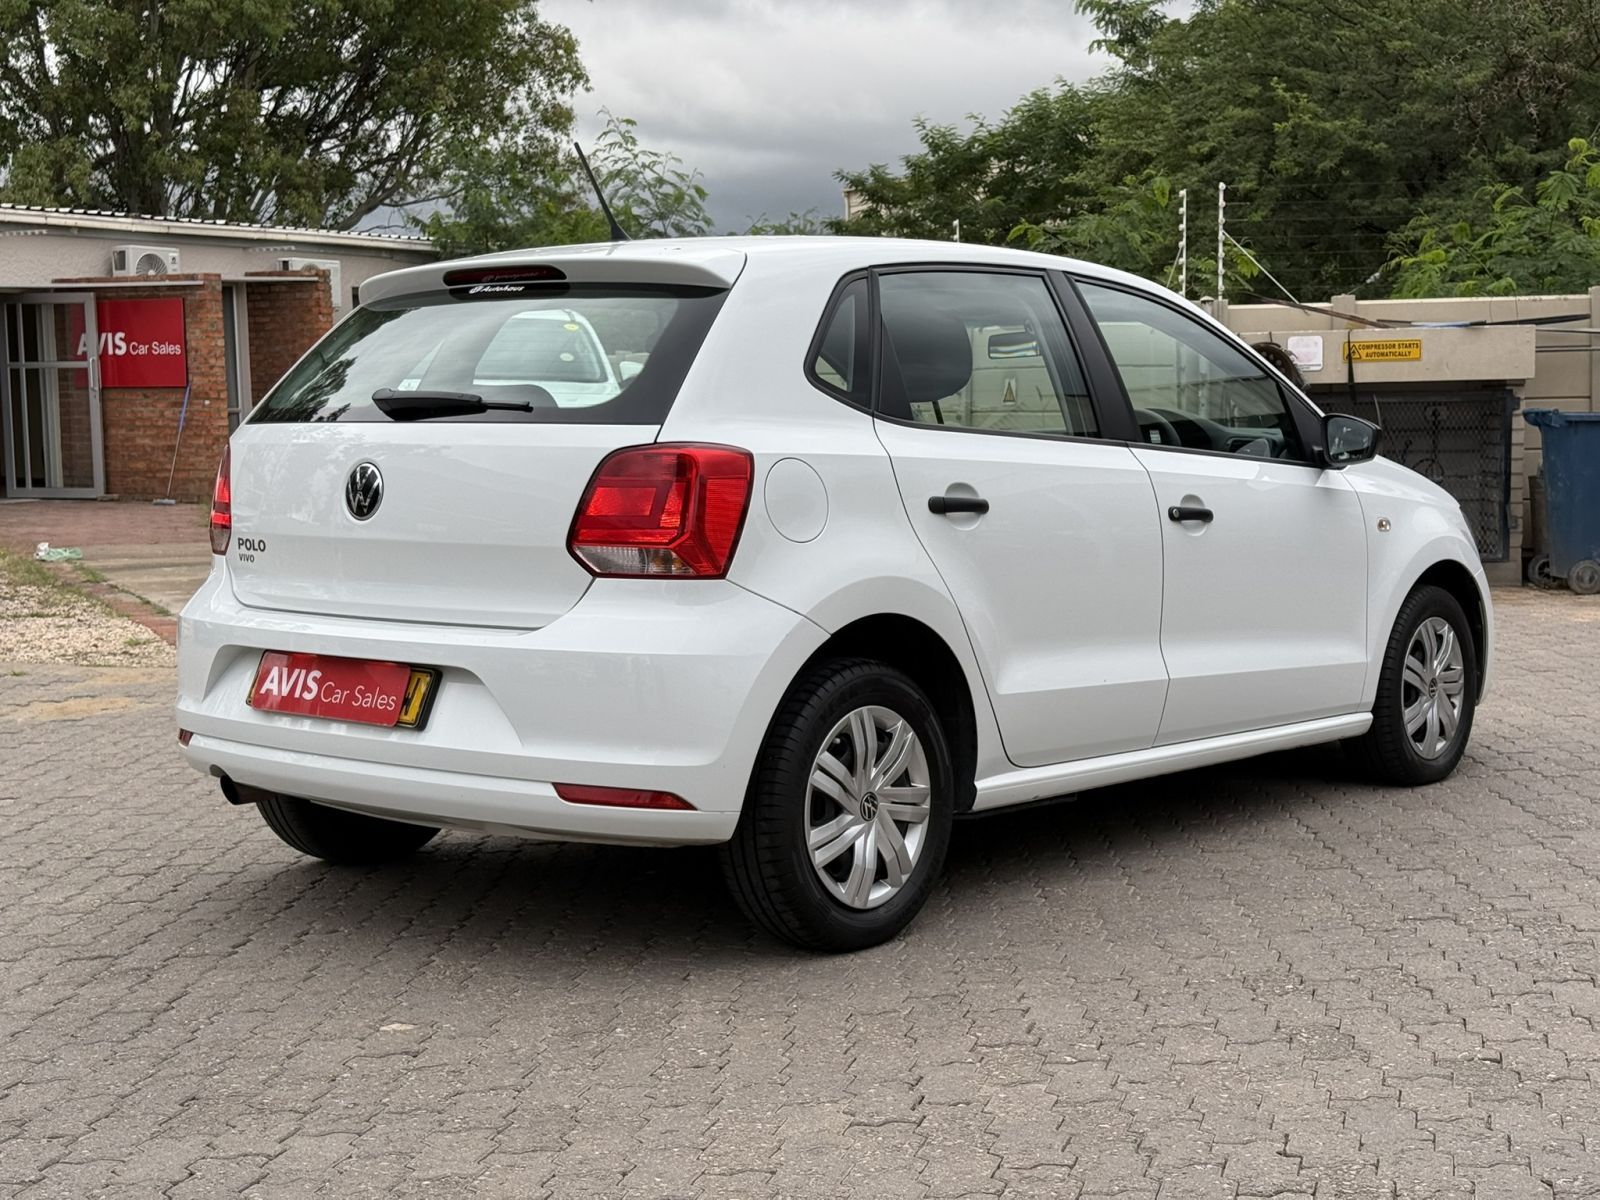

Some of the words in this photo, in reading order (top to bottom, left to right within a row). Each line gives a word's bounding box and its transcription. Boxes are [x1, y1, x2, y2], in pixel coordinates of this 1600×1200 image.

[129, 341, 149, 356] Car
[151, 341, 182, 356] Sales
[1398, 342, 1419, 350] STARTS
[1365, 350, 1412, 358] AUTOMATICALLY
[237, 537, 266, 552] POLO
[238, 553, 255, 563] VIVO
[259, 666, 323, 701] AVIS
[320, 681, 350, 704] Car
[351, 685, 397, 711] Sales
